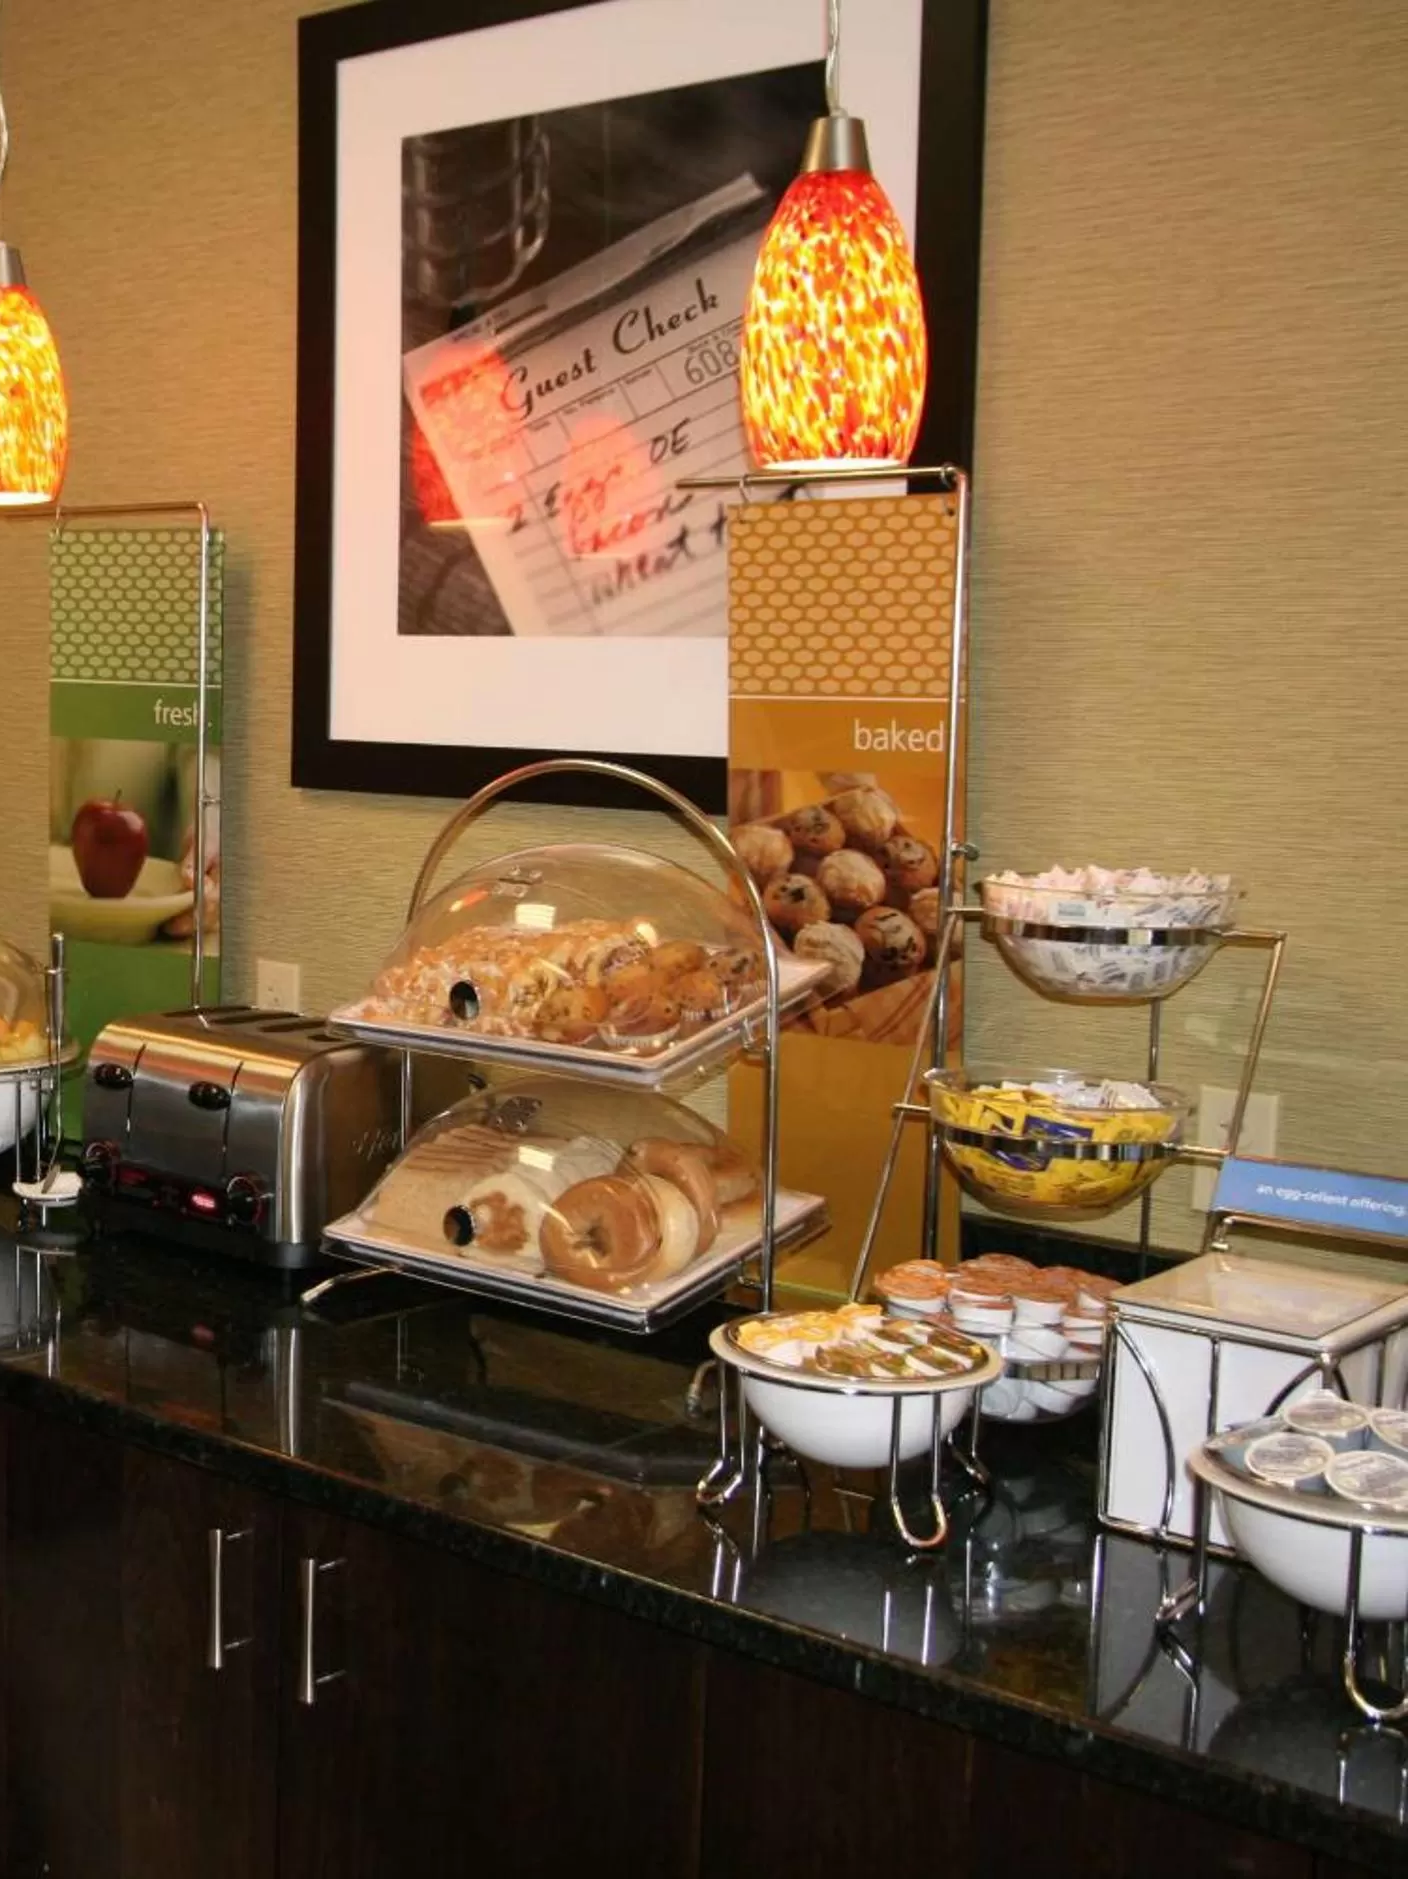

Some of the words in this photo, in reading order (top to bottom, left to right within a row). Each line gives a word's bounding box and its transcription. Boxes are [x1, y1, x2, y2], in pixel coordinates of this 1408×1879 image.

[500, 347, 597, 421] Guest
[612, 277, 719, 355] Check
[683, 340, 739, 385] 608
